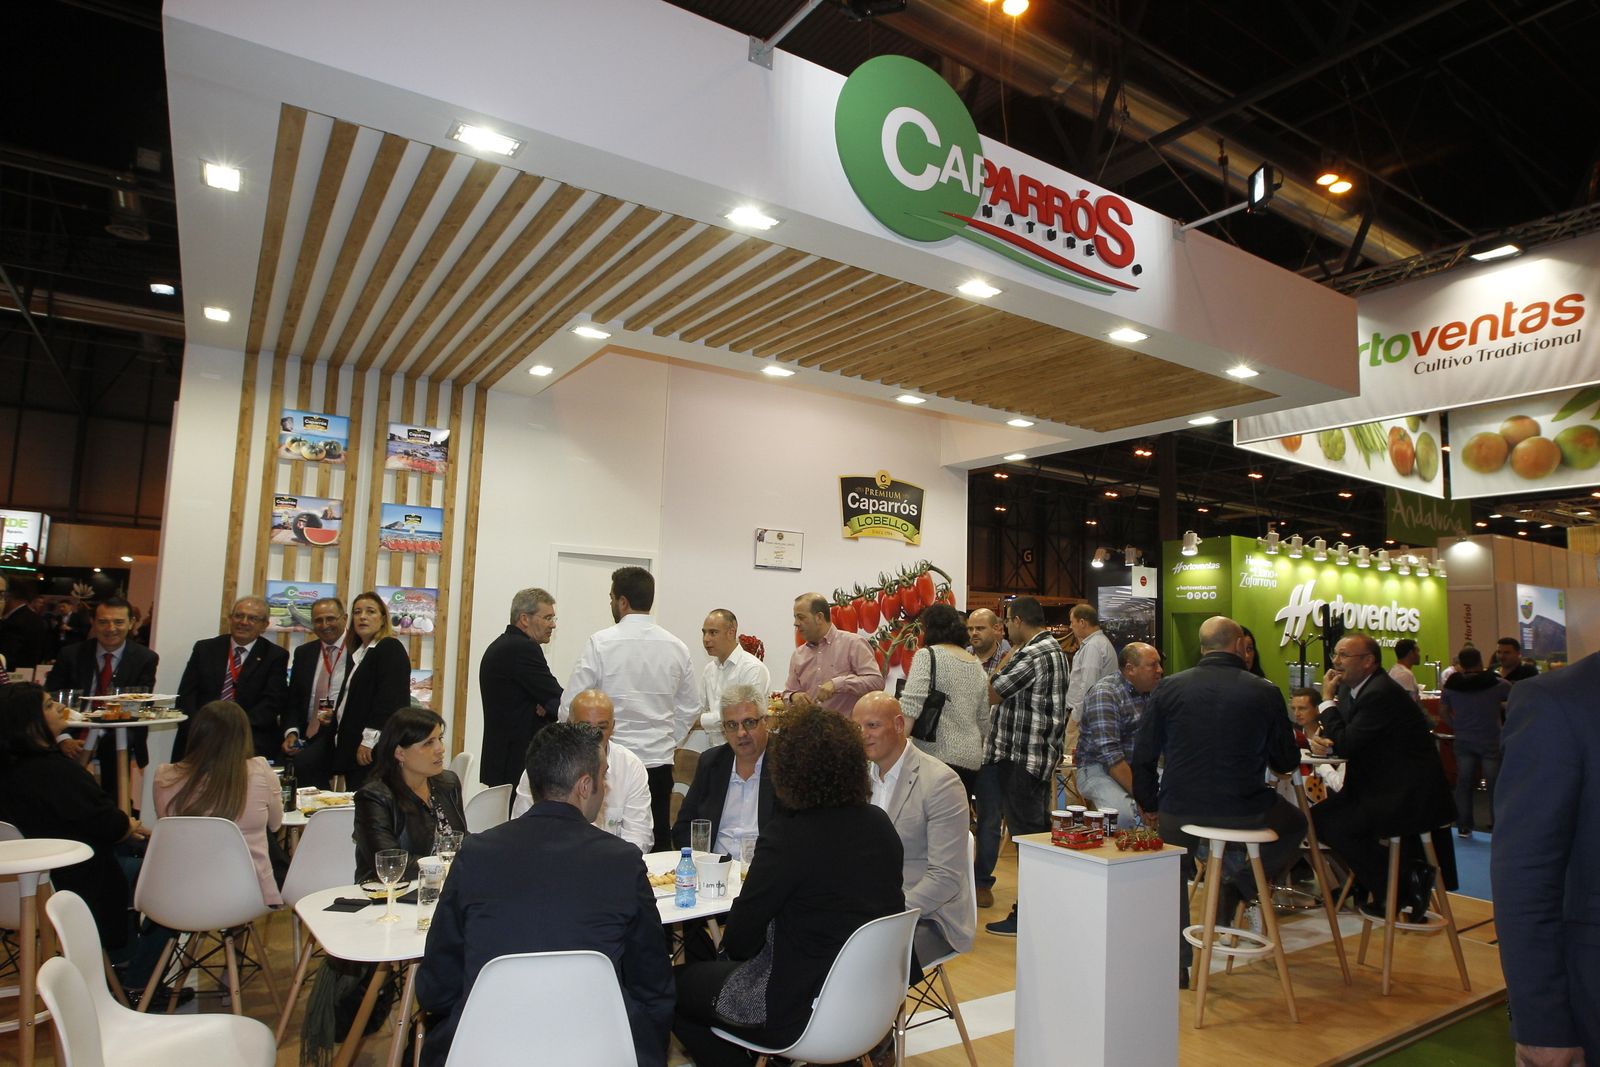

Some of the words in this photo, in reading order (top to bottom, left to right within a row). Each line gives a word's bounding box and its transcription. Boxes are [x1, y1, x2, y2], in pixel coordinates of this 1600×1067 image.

[981, 204, 1095, 257] NATURE
[1413, 354, 1473, 376] Cultivo
[1476, 329, 1582, 363] Tradicional
[863, 487, 901, 500] PREMIUM
[847, 492, 918, 516] Caparrós
[857, 516, 909, 532] LOBELLO
[1023, 550, 1032, 562] G
[1172, 561, 1221, 575] Hortoventas
[1463, 603, 1473, 641] Hortisol
